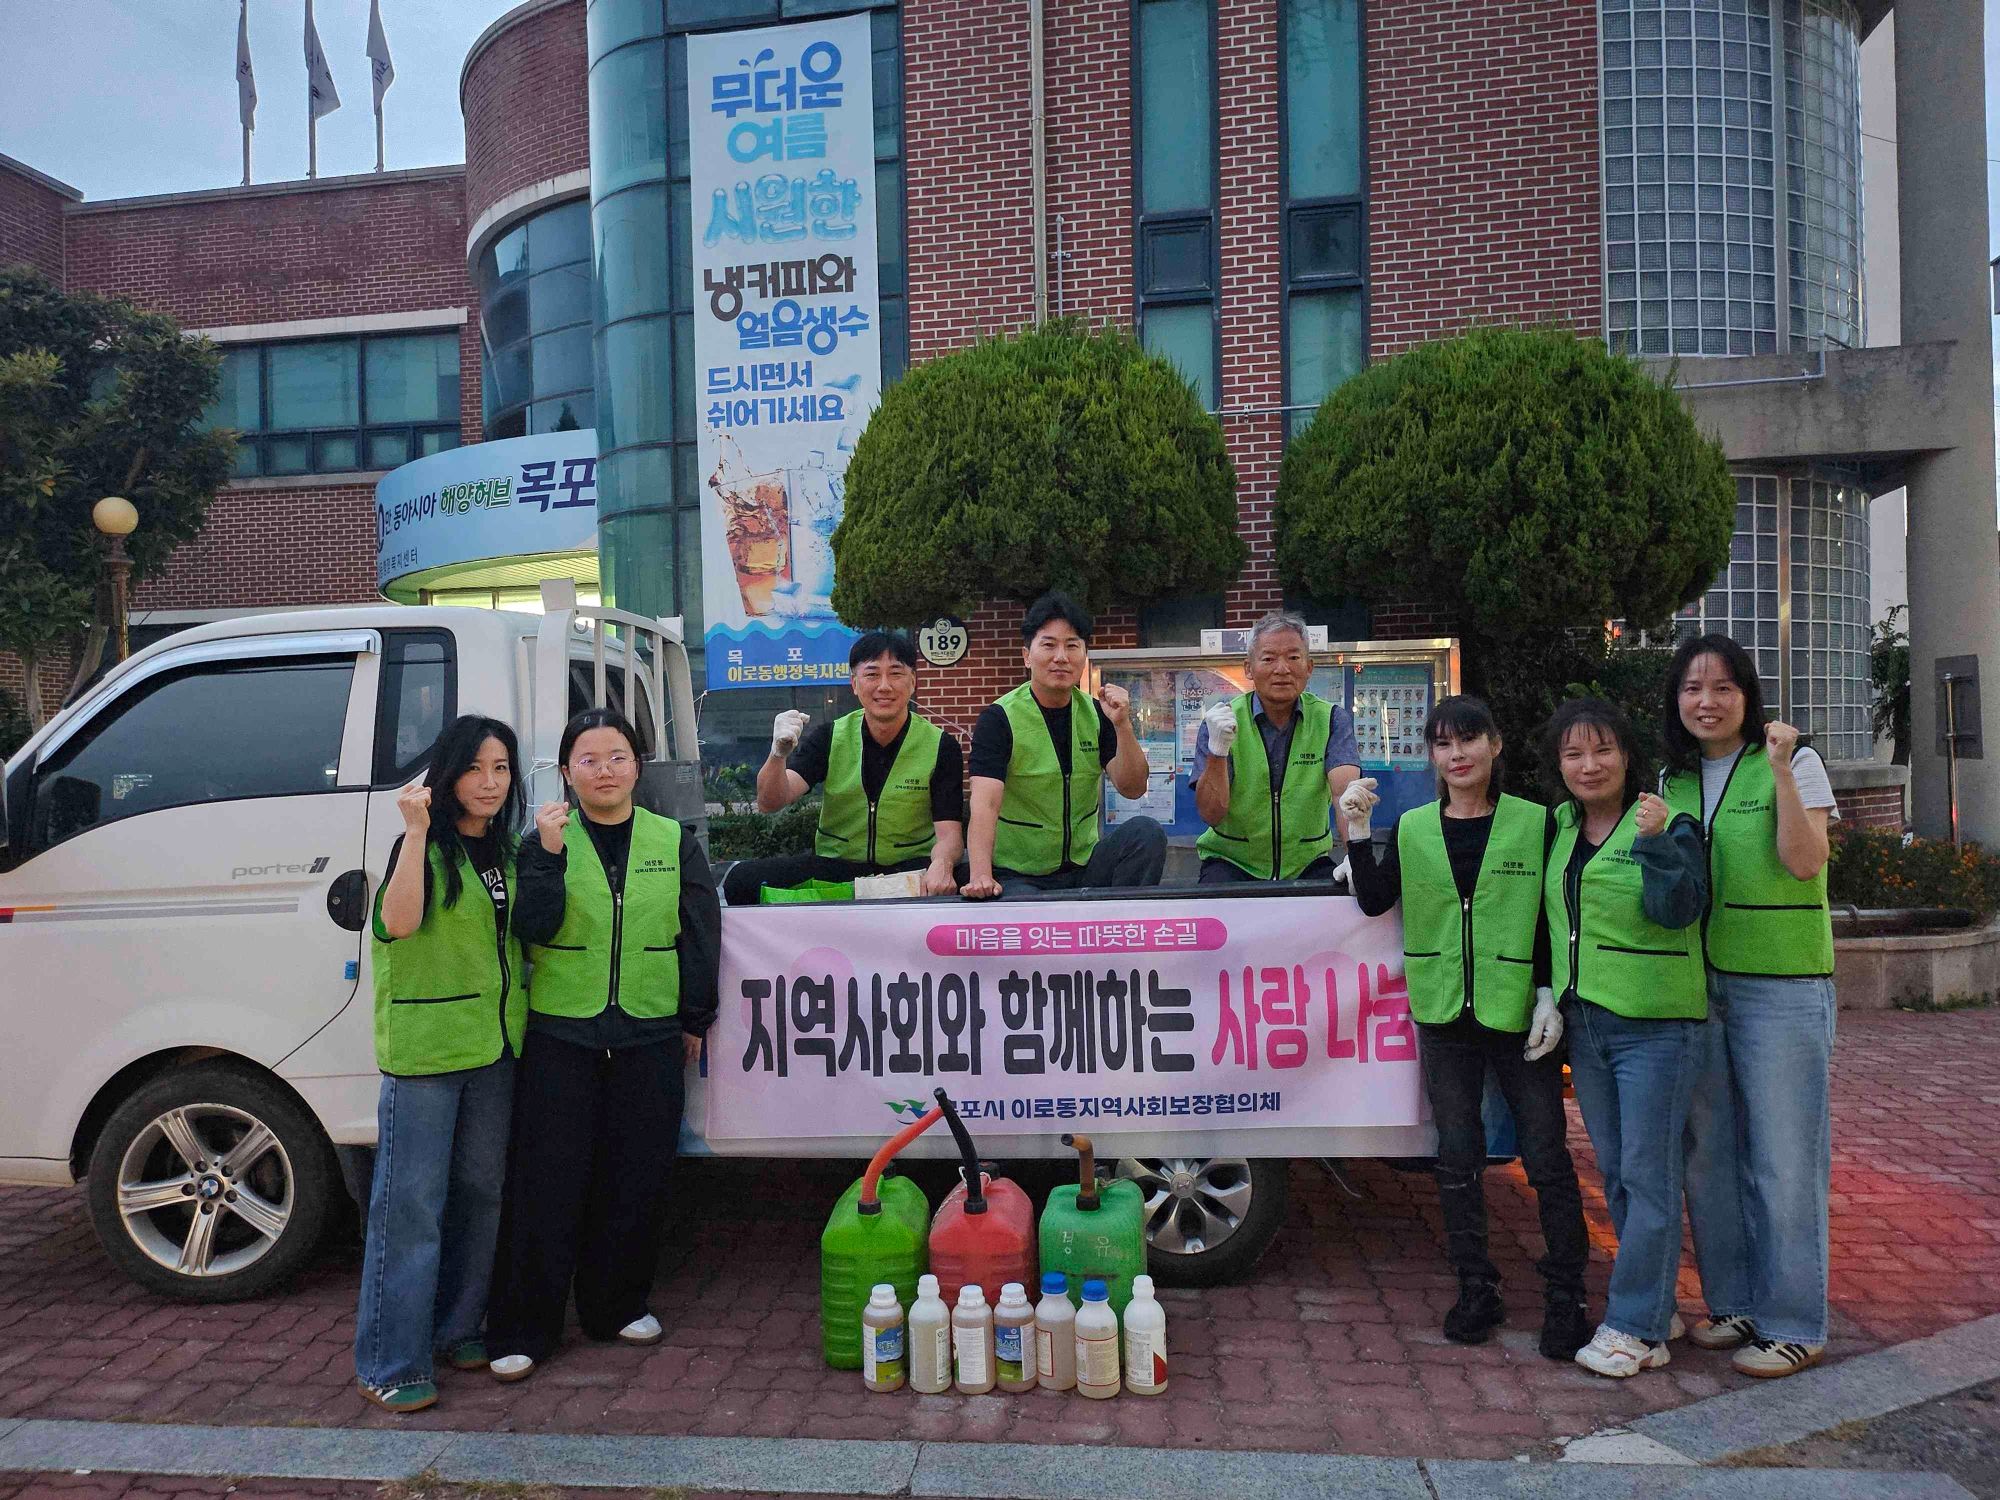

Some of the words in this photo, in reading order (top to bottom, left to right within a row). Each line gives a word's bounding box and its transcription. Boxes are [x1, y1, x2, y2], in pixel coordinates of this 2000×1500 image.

[711, 41, 843, 118] 무더운
[727, 112, 828, 163] 여름
[703, 168, 862, 249] 시원한
[703, 253, 857, 322] 냉커피와
[736, 299, 870, 355] 얼음생수
[707, 361, 813, 395] 드시면서
[707, 394, 845, 428] 쉬어가세요
[393, 492, 437, 531] 동아시아
[440, 476, 513, 517] 해양허브
[516, 457, 597, 513] 목포
[927, 635, 961, 650] 189
[727, 662, 850, 682] 이로동행정복지센
[231, 863, 316, 880] porter
[955, 926, 1022, 951] 마음을
[1028, 926, 1073, 950] 잇는
[1078, 923, 1147, 949] 따뜻한
[1153, 922, 1198, 946] 손길
[741, 971, 986, 1077] 지역사회와
[998, 969, 1195, 1075] 함께하는
[1212, 963, 1311, 1071] 사랑
[1325, 962, 1417, 1063] 나눔
[1012, 1091, 1281, 1120] 이로동지역사회보장협의체
